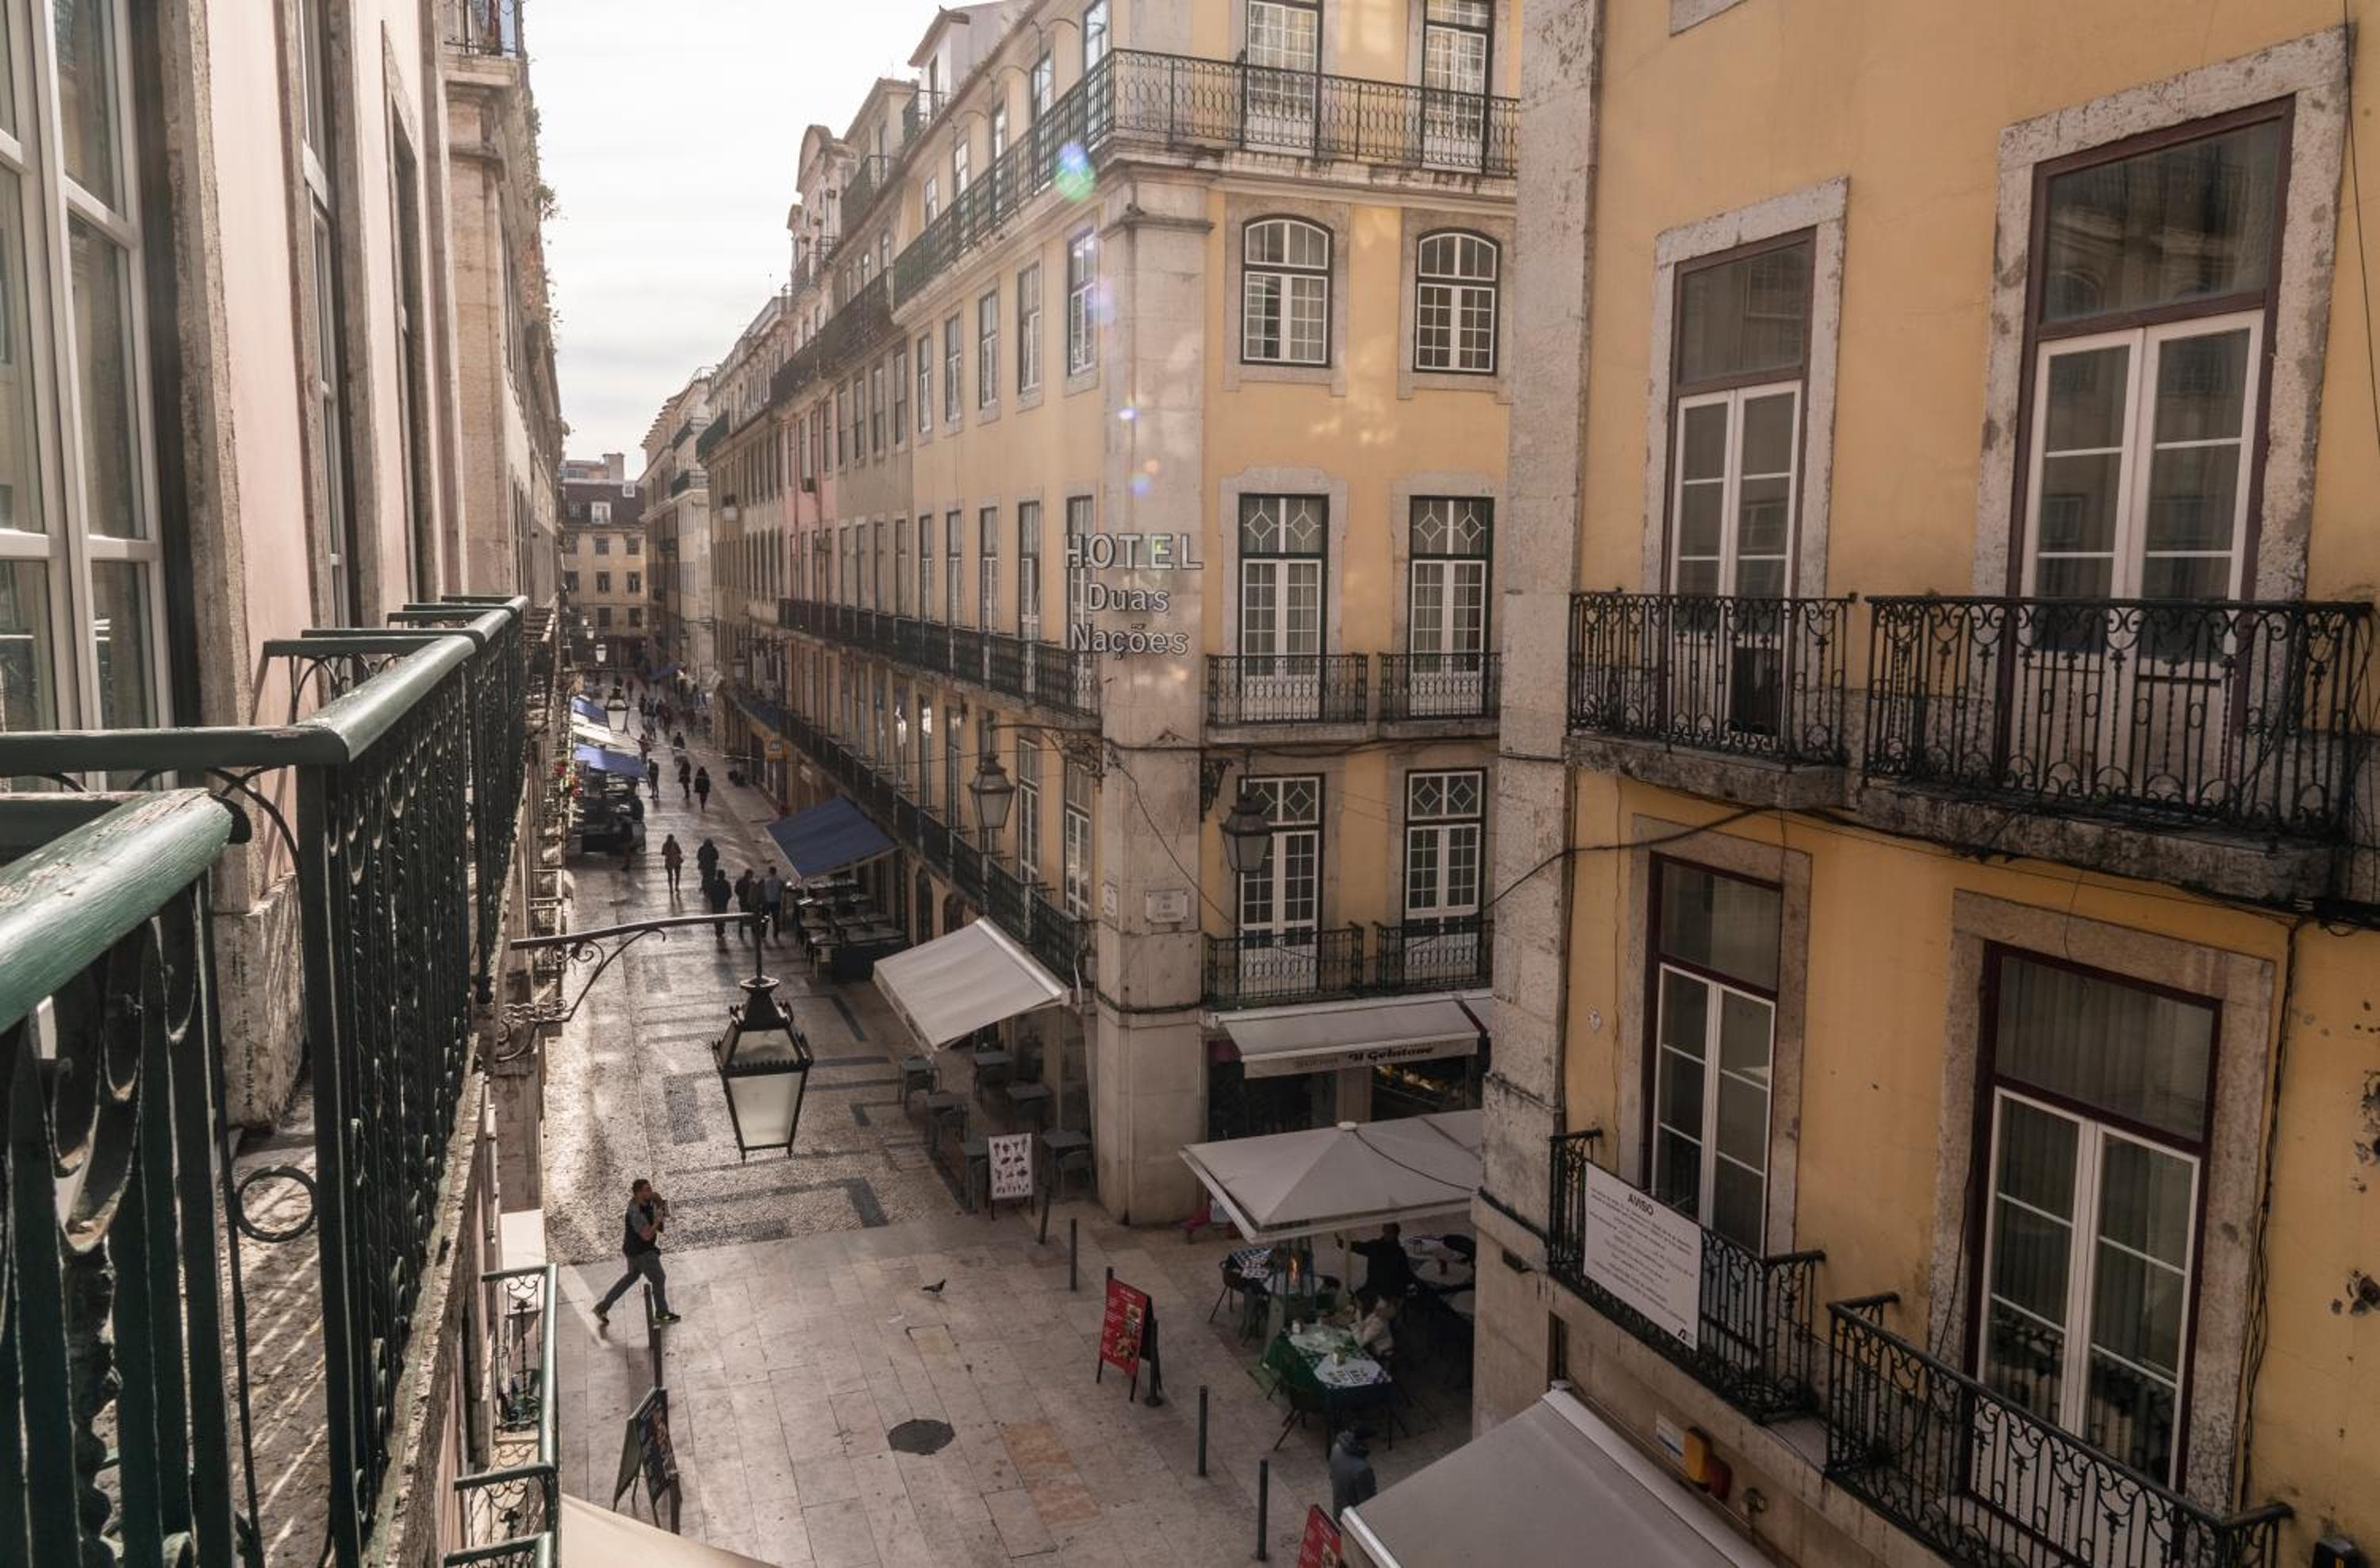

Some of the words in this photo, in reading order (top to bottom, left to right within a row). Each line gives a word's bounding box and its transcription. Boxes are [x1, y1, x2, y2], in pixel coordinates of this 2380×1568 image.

[1065, 533, 1203, 569] HOTEL
[1087, 582, 1170, 613] Duas
[1070, 623, 1189, 660] Nações
